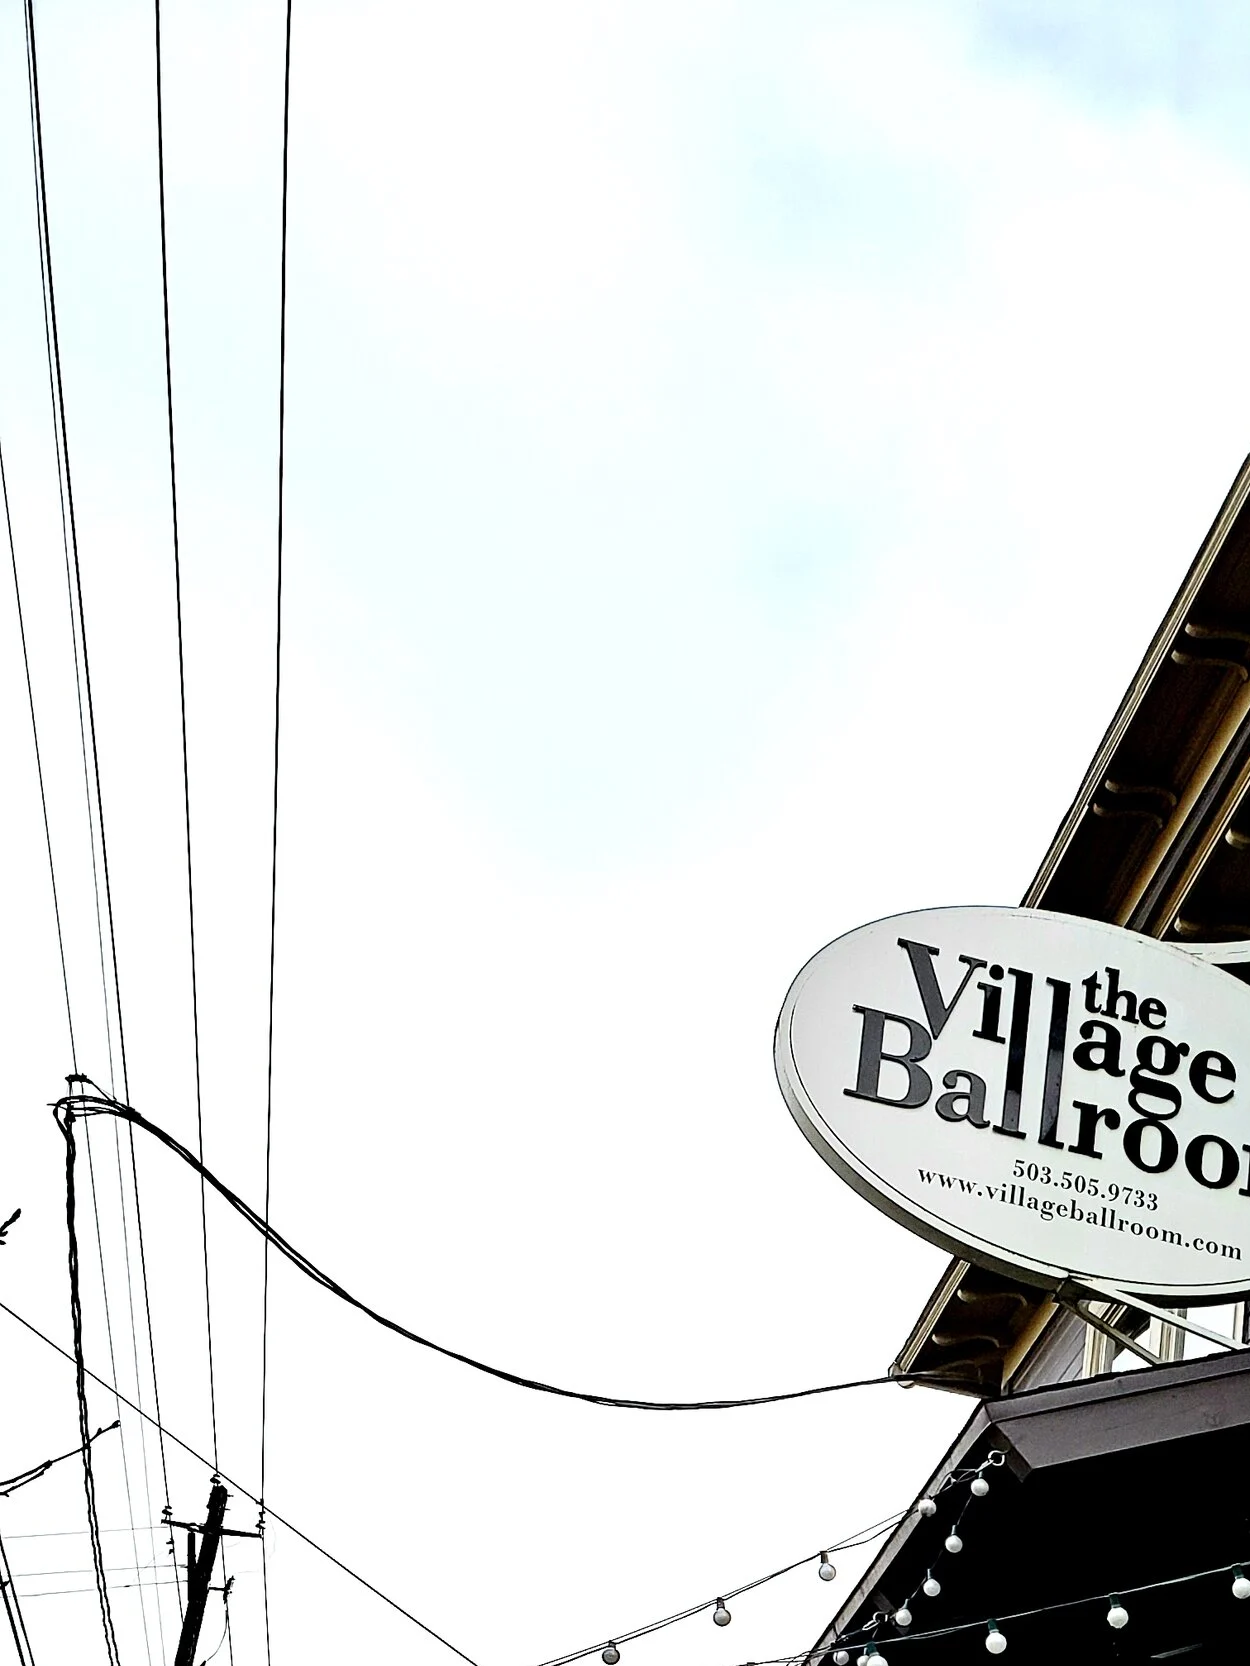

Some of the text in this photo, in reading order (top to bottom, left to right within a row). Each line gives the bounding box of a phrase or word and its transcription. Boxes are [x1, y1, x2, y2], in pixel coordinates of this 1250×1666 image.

[897, 937, 1237, 1124] Village
[1081, 966, 1168, 1030] the
[916, 1166, 1243, 1261] www.villageballroom.com
[1012, 1158, 1160, 1213] 503.505.9733
